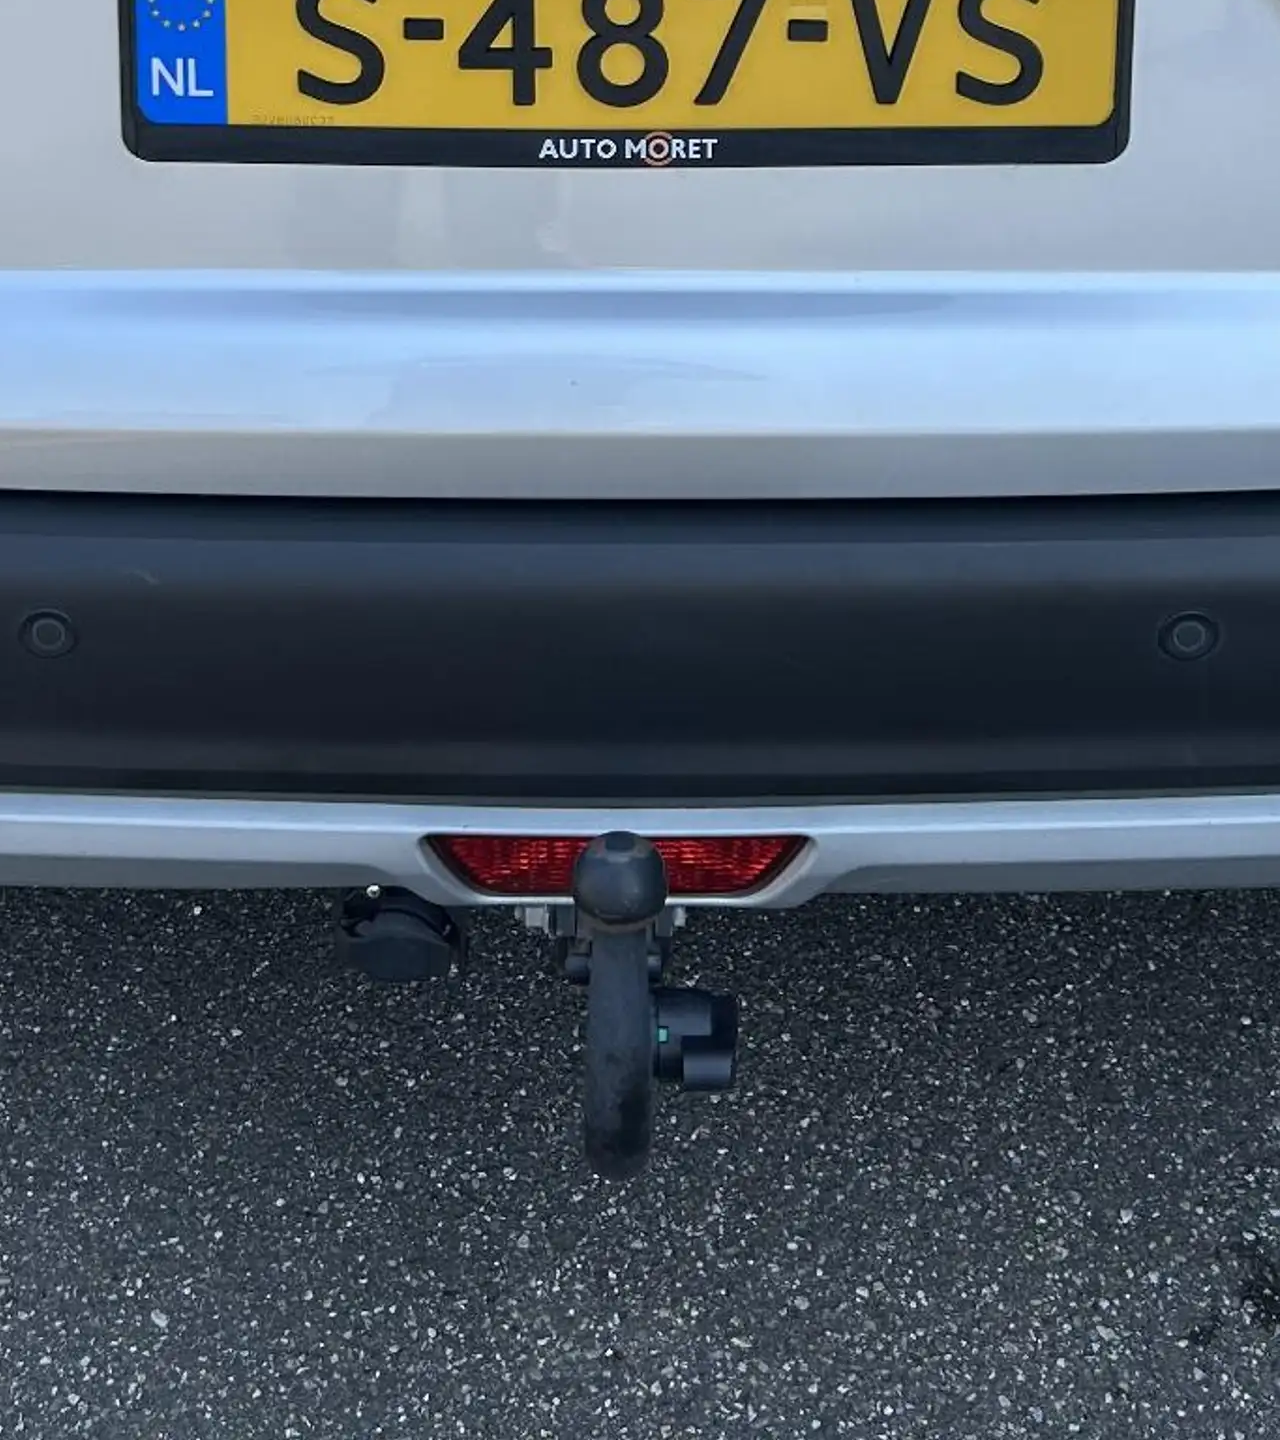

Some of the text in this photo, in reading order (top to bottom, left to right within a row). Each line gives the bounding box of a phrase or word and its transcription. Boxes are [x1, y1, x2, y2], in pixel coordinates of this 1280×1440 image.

[150, 58, 214, 98] NL
[538, 135, 718, 162] AUTO MORET
